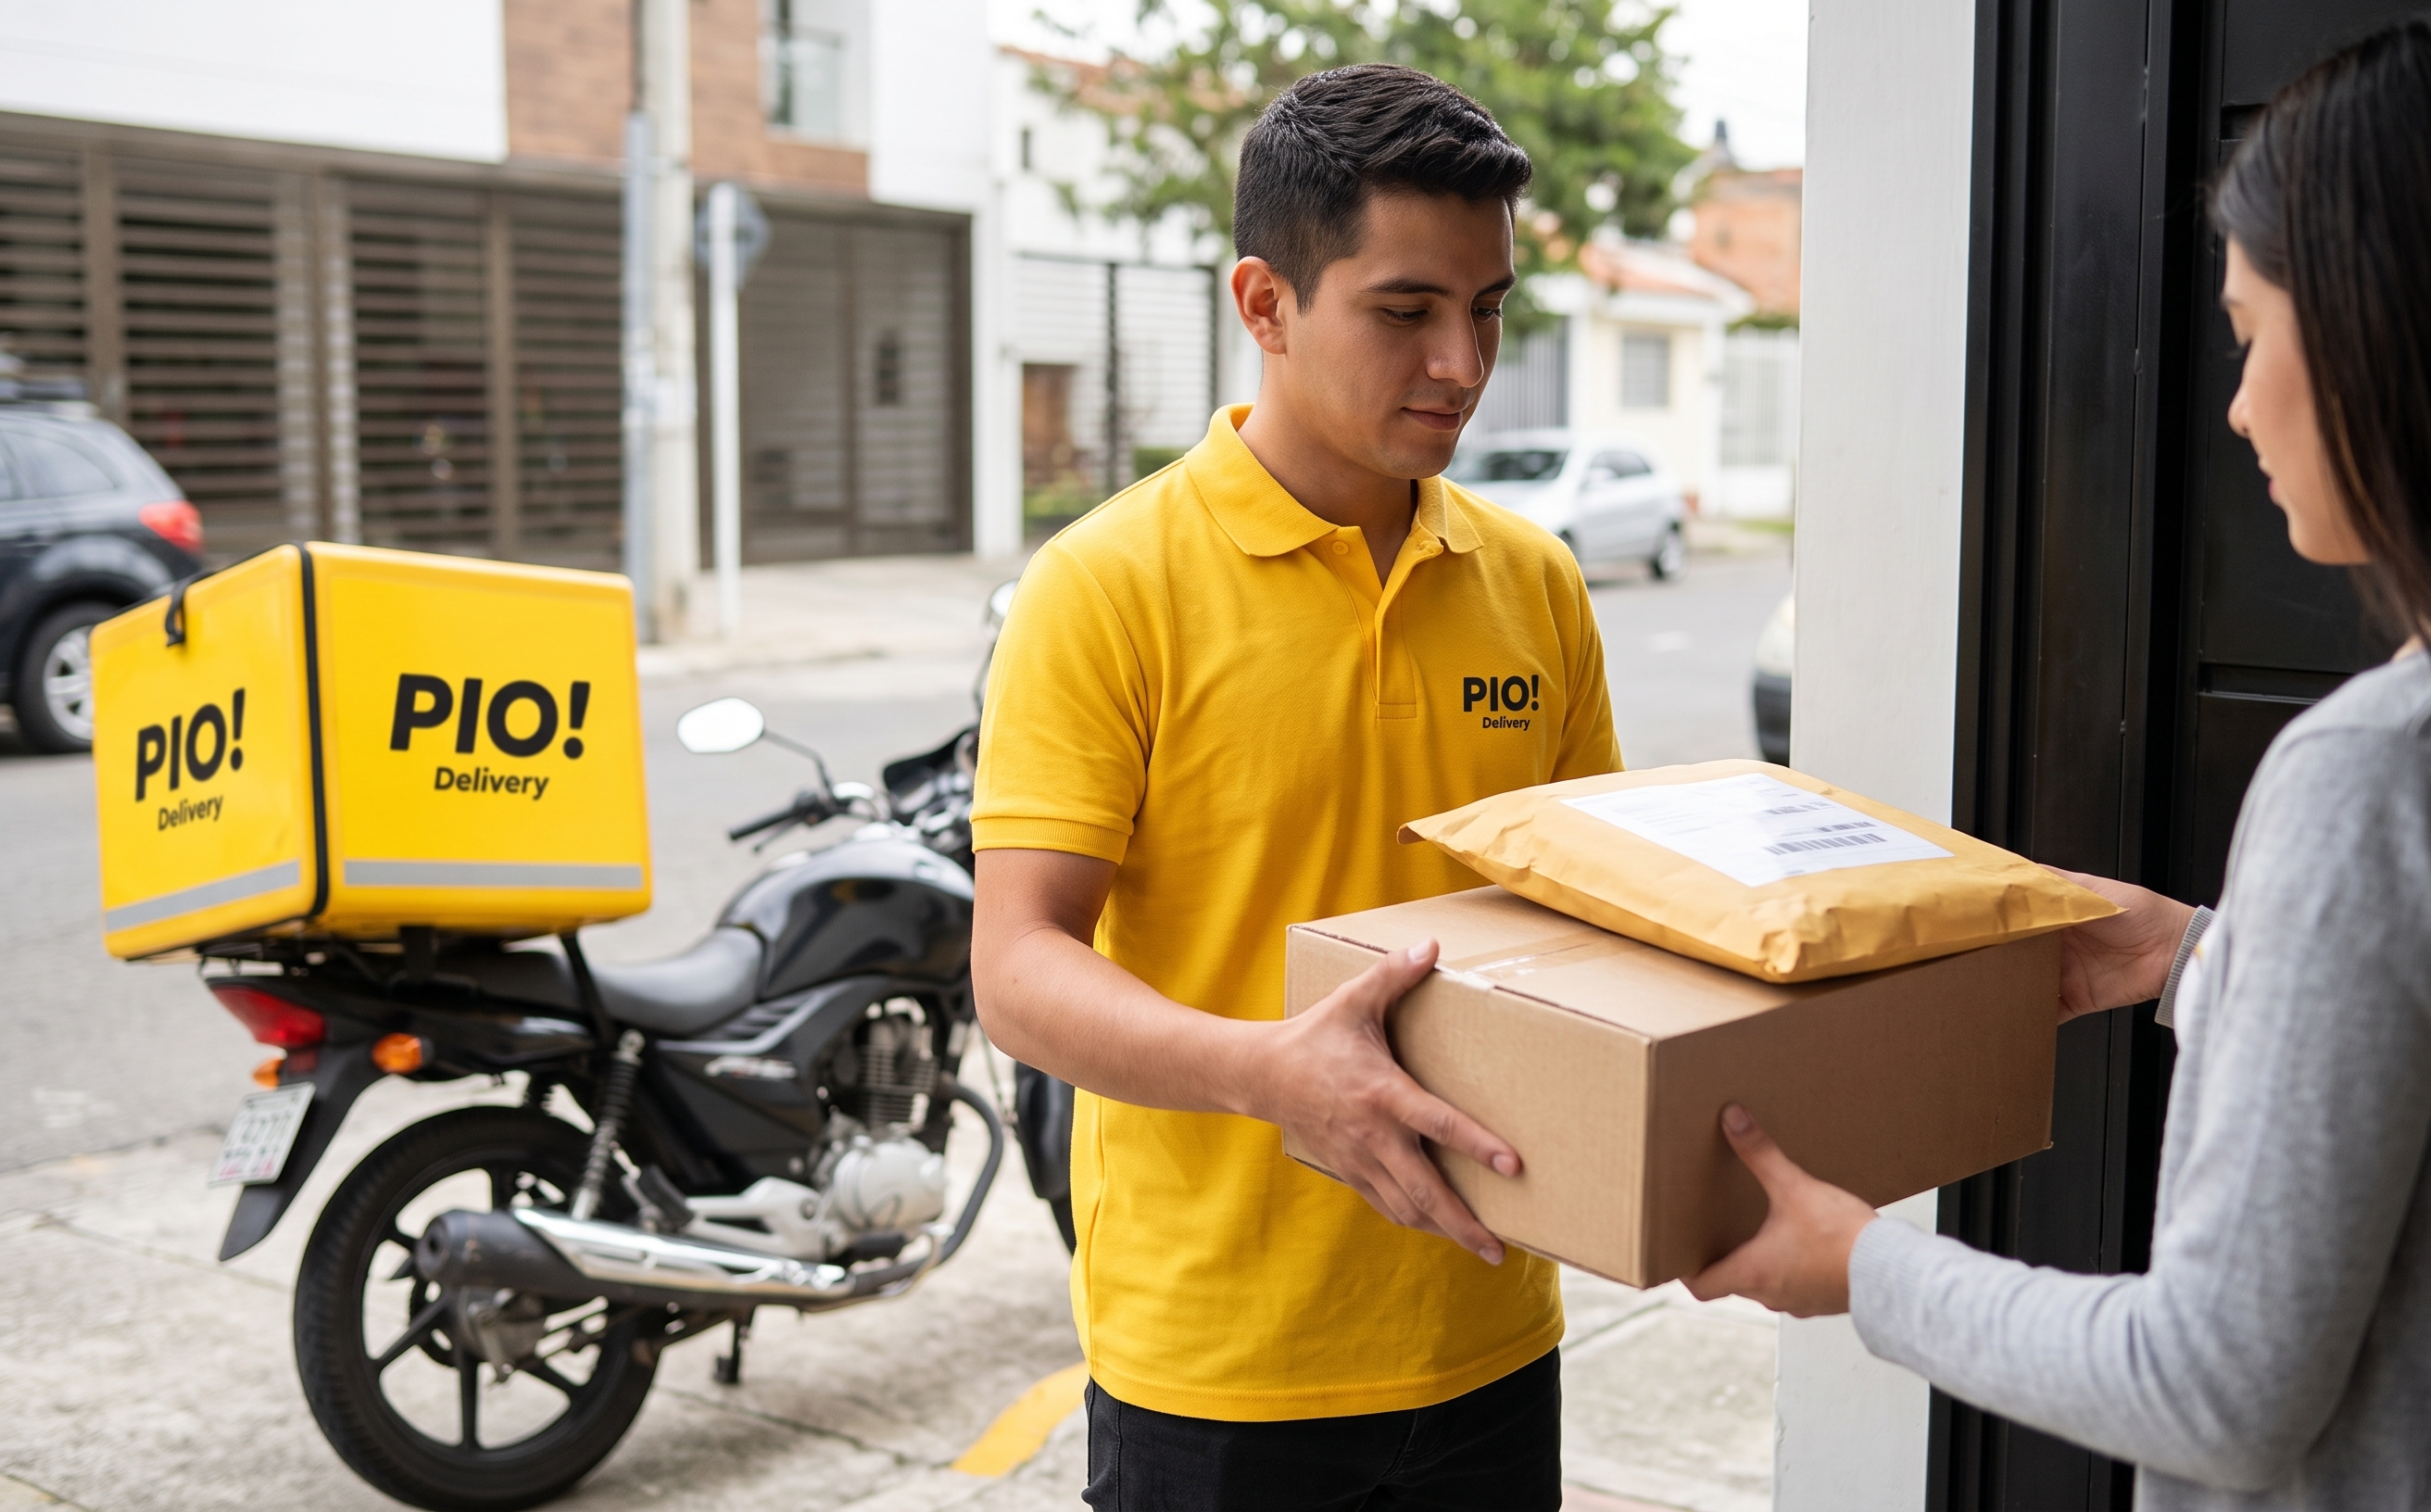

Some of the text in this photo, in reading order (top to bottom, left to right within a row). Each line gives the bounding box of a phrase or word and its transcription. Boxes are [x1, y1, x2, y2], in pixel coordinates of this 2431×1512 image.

[1463, 674, 1540, 712] PIO!
[390, 673, 591, 760] PIO!
[1482, 716, 1531, 732] Delivery
[135, 687, 246, 802] PIO!
[434, 766, 549, 800] Delivery
[157, 794, 224, 831] Delivery
